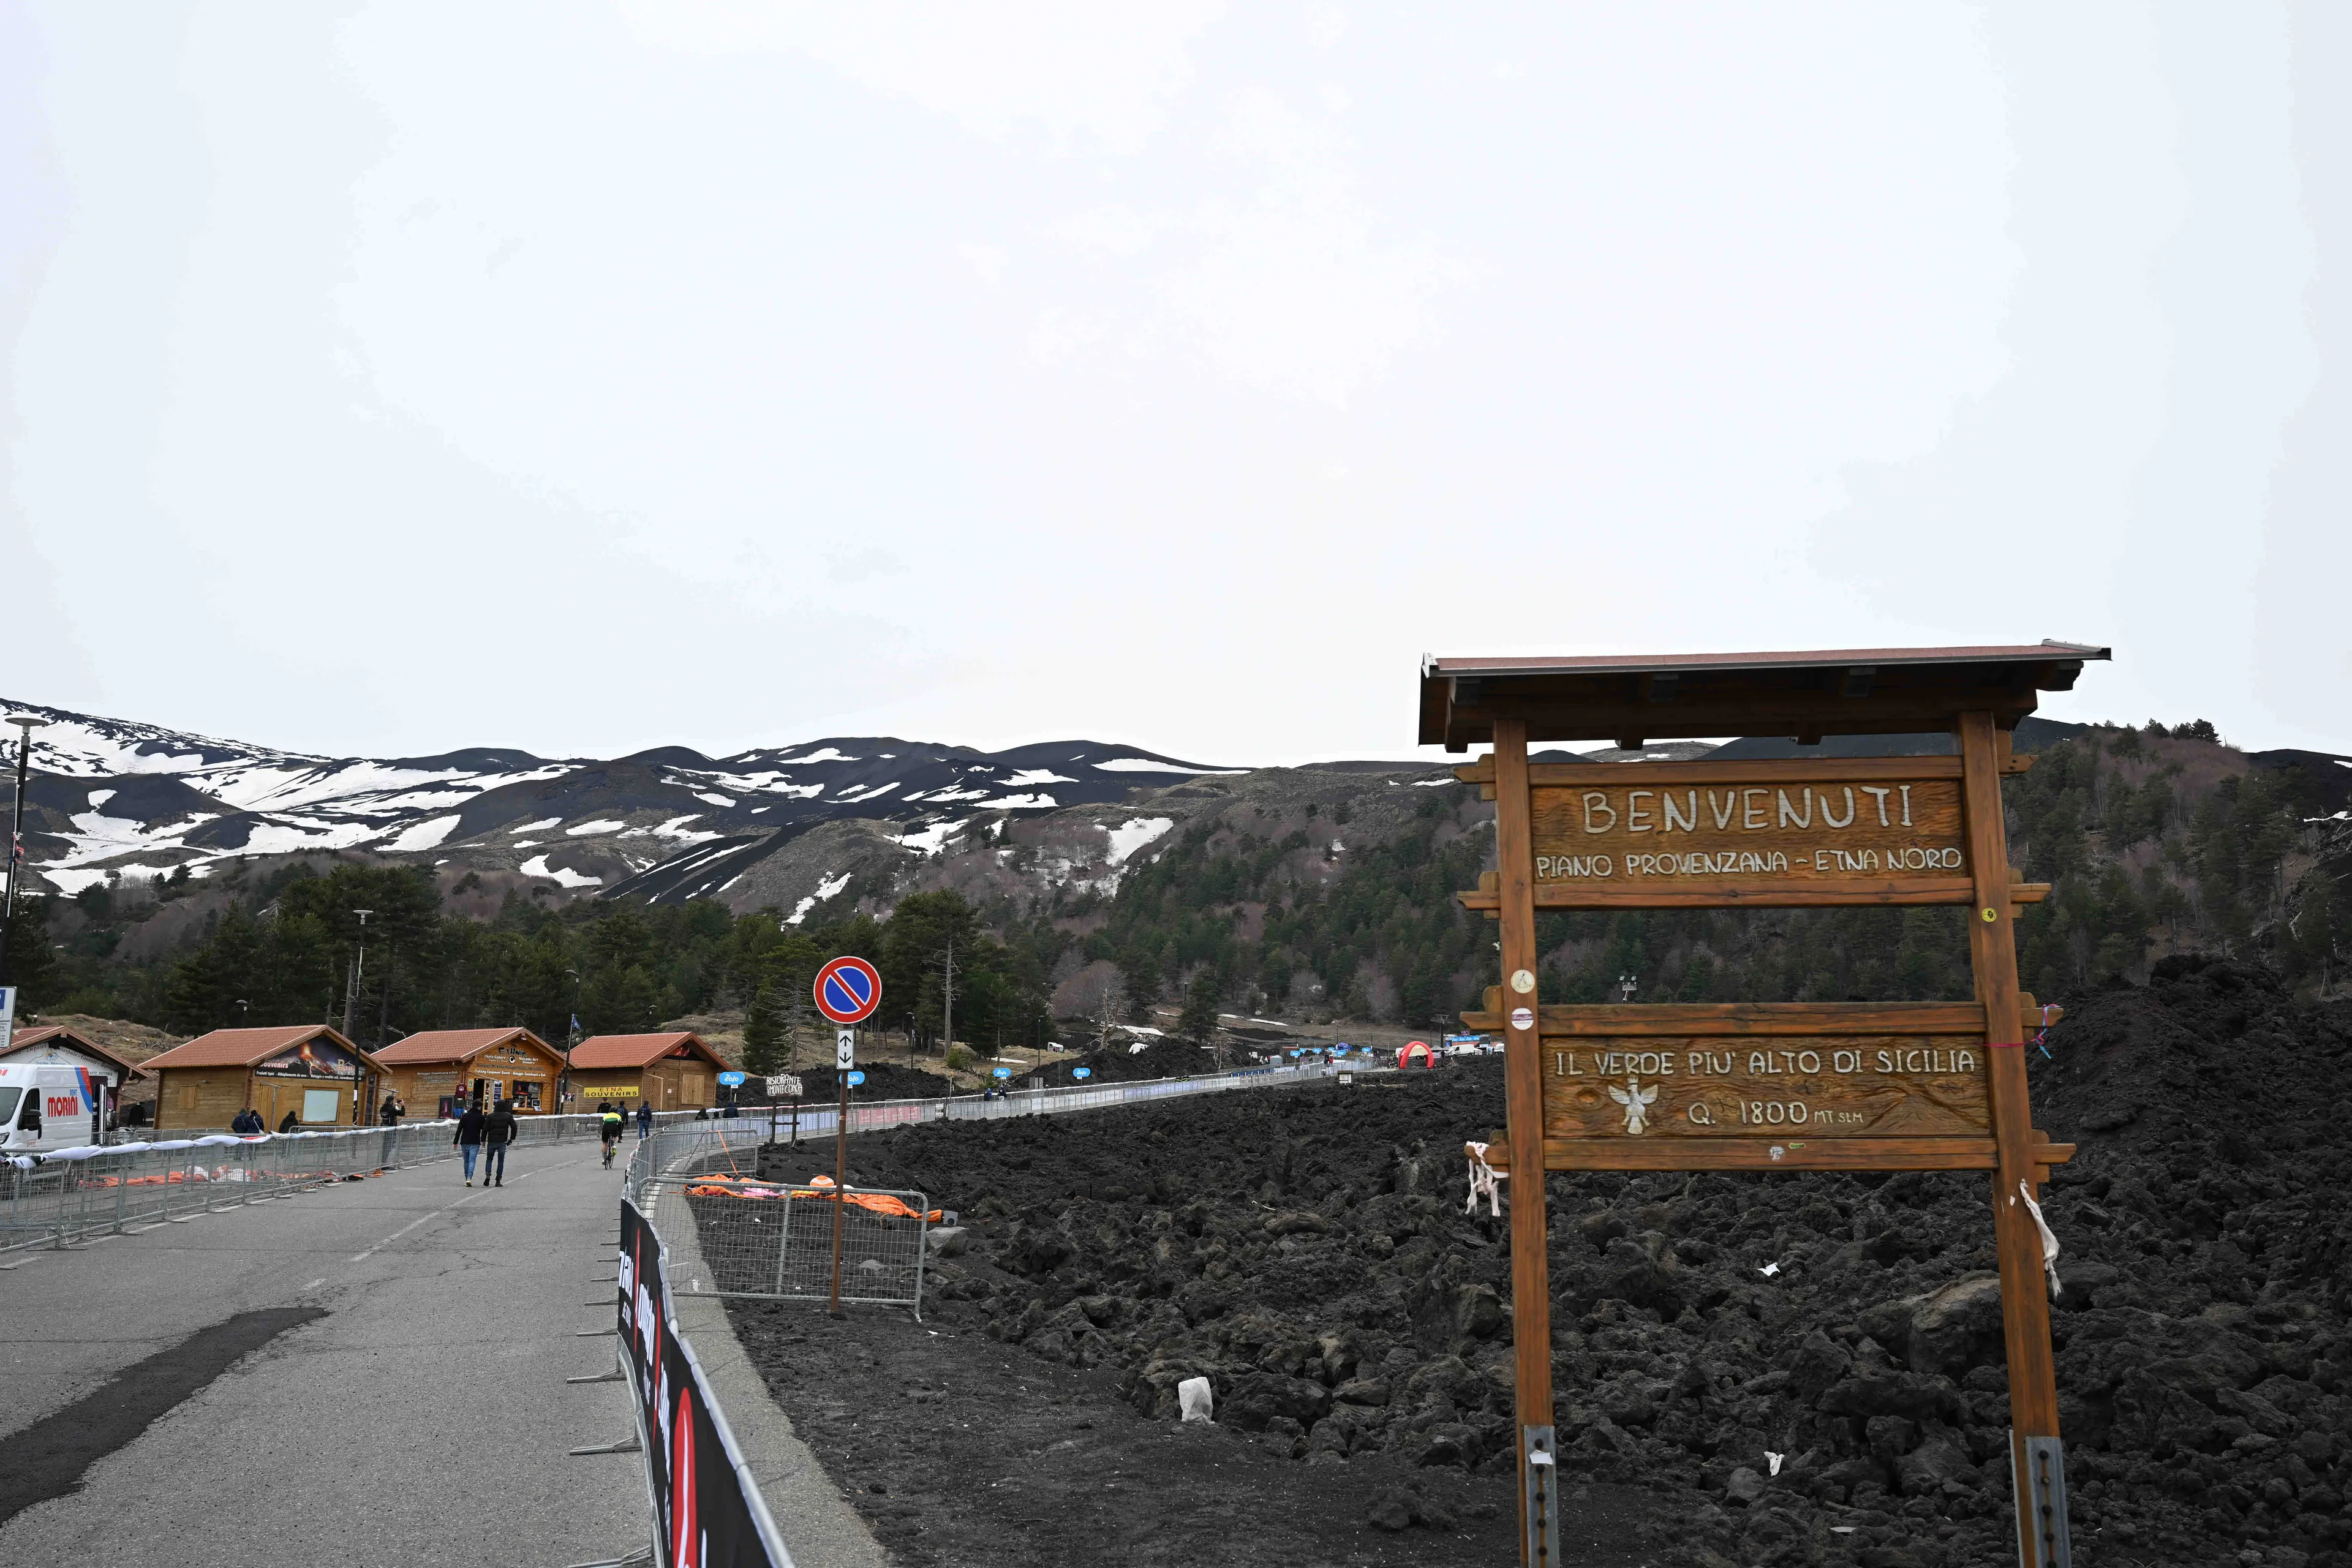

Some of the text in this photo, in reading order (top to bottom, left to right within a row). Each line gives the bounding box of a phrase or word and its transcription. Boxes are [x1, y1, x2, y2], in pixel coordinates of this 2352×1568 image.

[1582, 785, 1913, 834] BENVENUTI
[1536, 854, 1613, 878] PIANO
[1626, 851, 1788, 875] PROVENZANA
[1815, 849, 1879, 872] ETNA
[1887, 847, 1962, 869] NORD
[1555, 1049, 1975, 1076] IL VERDE PIU' ALTO DI SICILIA
[767, 1073, 801, 1085] RISTORANTE
[47, 1096, 78, 1117] MORINI
[1688, 1100, 1864, 1125] Q. 1800 MT SLM
